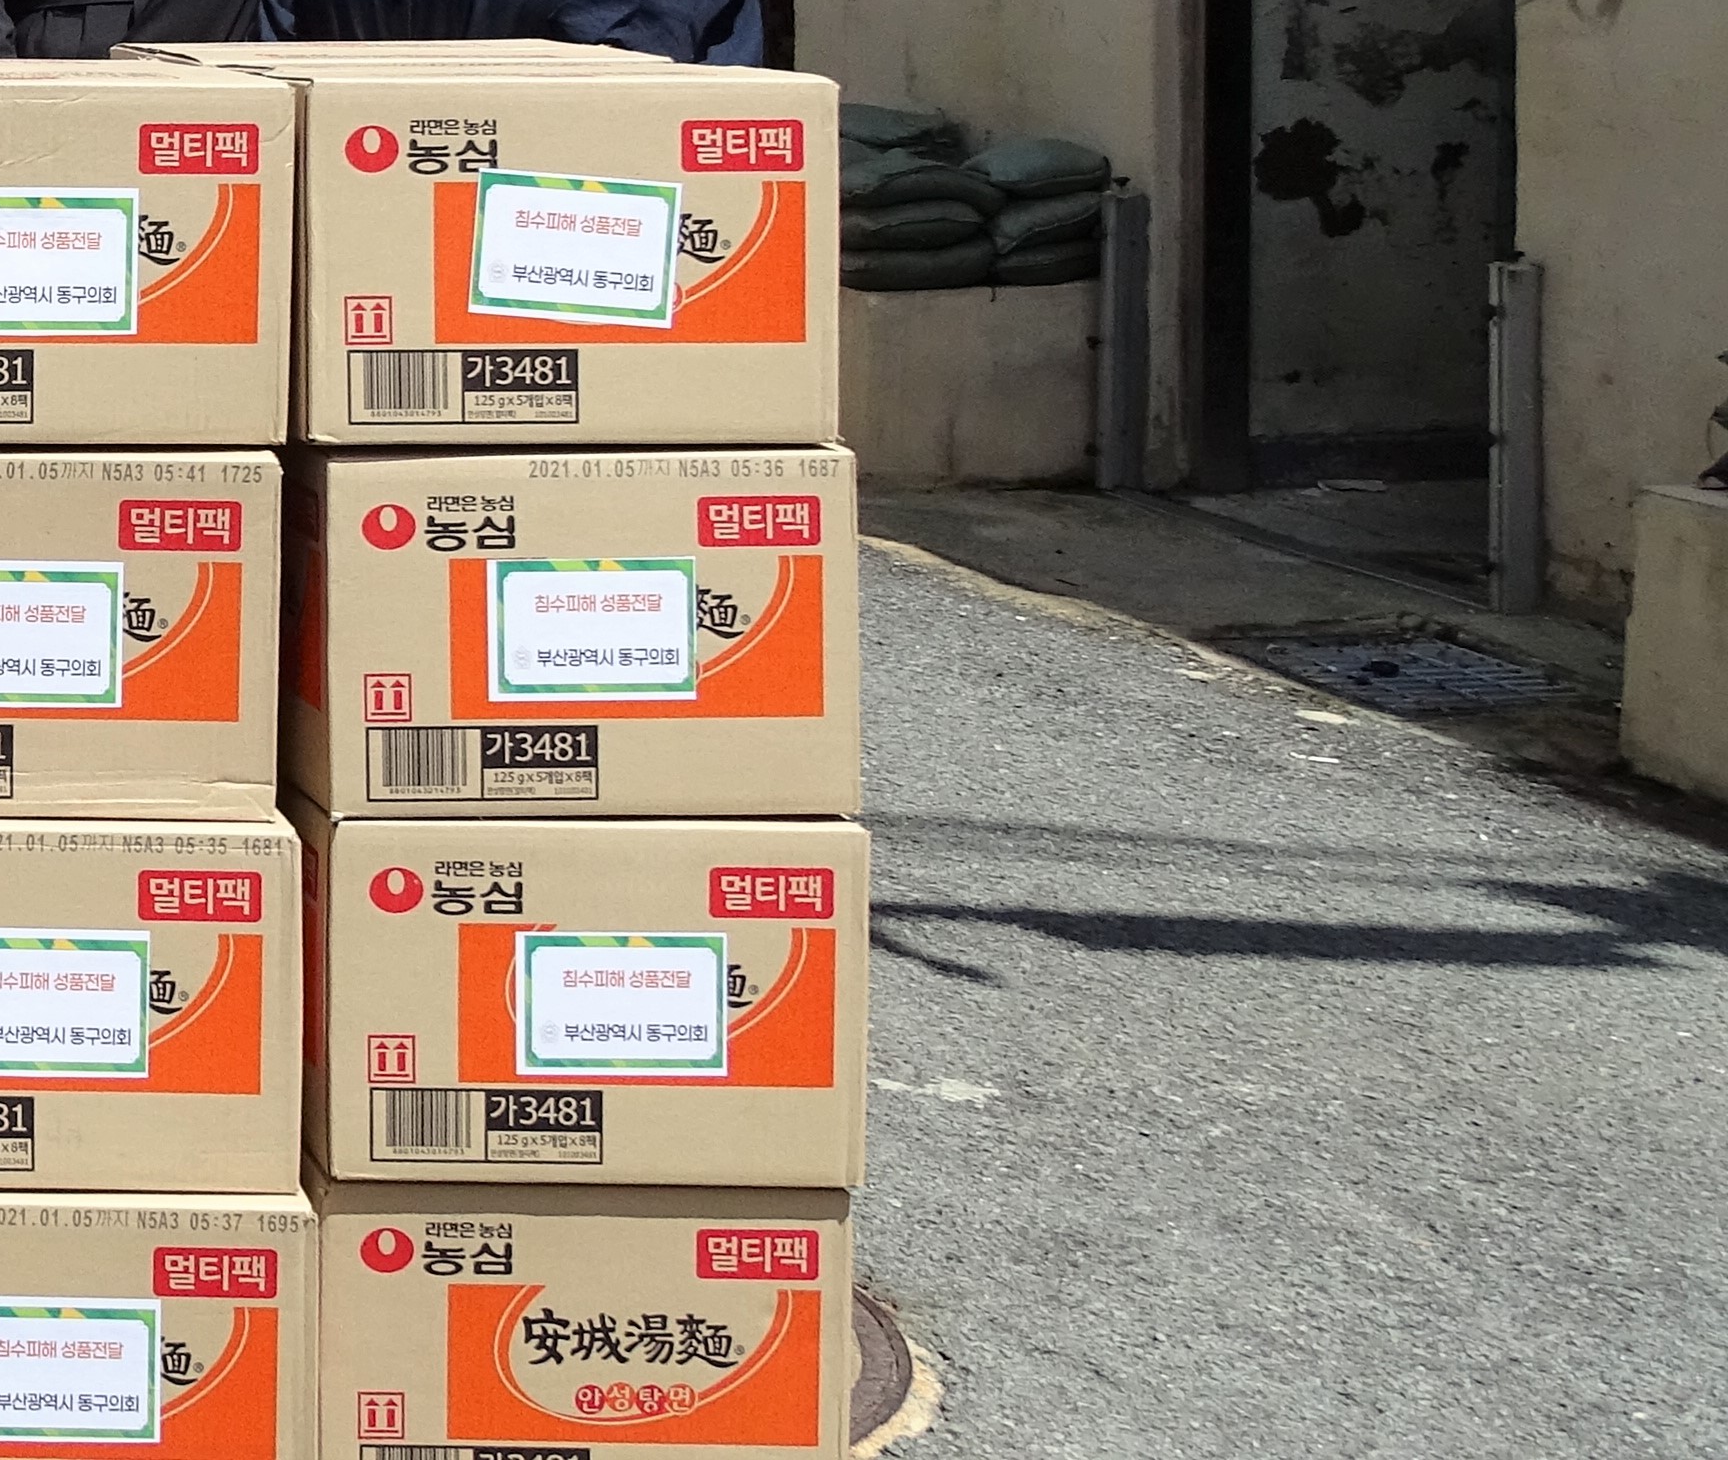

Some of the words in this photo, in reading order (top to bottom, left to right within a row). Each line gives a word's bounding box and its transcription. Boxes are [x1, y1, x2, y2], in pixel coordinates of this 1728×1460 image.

[150, 130, 248, 167] 멀티팩
[406, 138, 499, 174] 농심
[691, 128, 792, 164] 멀티팩
[515, 209, 577, 232] 침수피해
[580, 214, 643, 238] 성품전달
[512, 264, 589, 289] 부산광역시
[592, 268, 654, 292] 동구의회
[467, 355, 572, 388] 가3481
[101, 463, 144, 481] N5A3
[154, 465, 206, 482] 05:41
[221, 465, 262, 483] 1725
[678, 460, 721, 479] N5A3
[731, 459, 784, 477] 05:36
[798, 458, 839, 477] 1687
[129, 508, 230, 545] 멀티팩
[424, 515, 516, 552] 농심
[708, 505, 810, 539] 멀티팩
[487, 732, 592, 765] 가3481
[122, 835, 164, 854] N5A3
[175, 837, 227, 855] 05:35
[242, 838, 283, 856] 1681
[148, 878, 250, 915] 멀티팩
[431, 882, 523, 916] 농심
[720, 875, 822, 912] 멀티팩
[490, 1096, 595, 1129] 가3481
[136, 1211, 179, 1229] N5A3
[190, 1213, 242, 1232] 05:37
[257, 1214, 298, 1233] 1695
[426, 1223, 476, 1238] 라면은
[479, 1223, 512, 1238] 농심
[422, 1242, 513, 1276] 농심
[706, 1236, 808, 1272] 멀티팩
[164, 1254, 265, 1290] 멀티팩
[522, 1309, 739, 1368] 安城湯麵
[579, 1386, 694, 1410] 안성탕면
